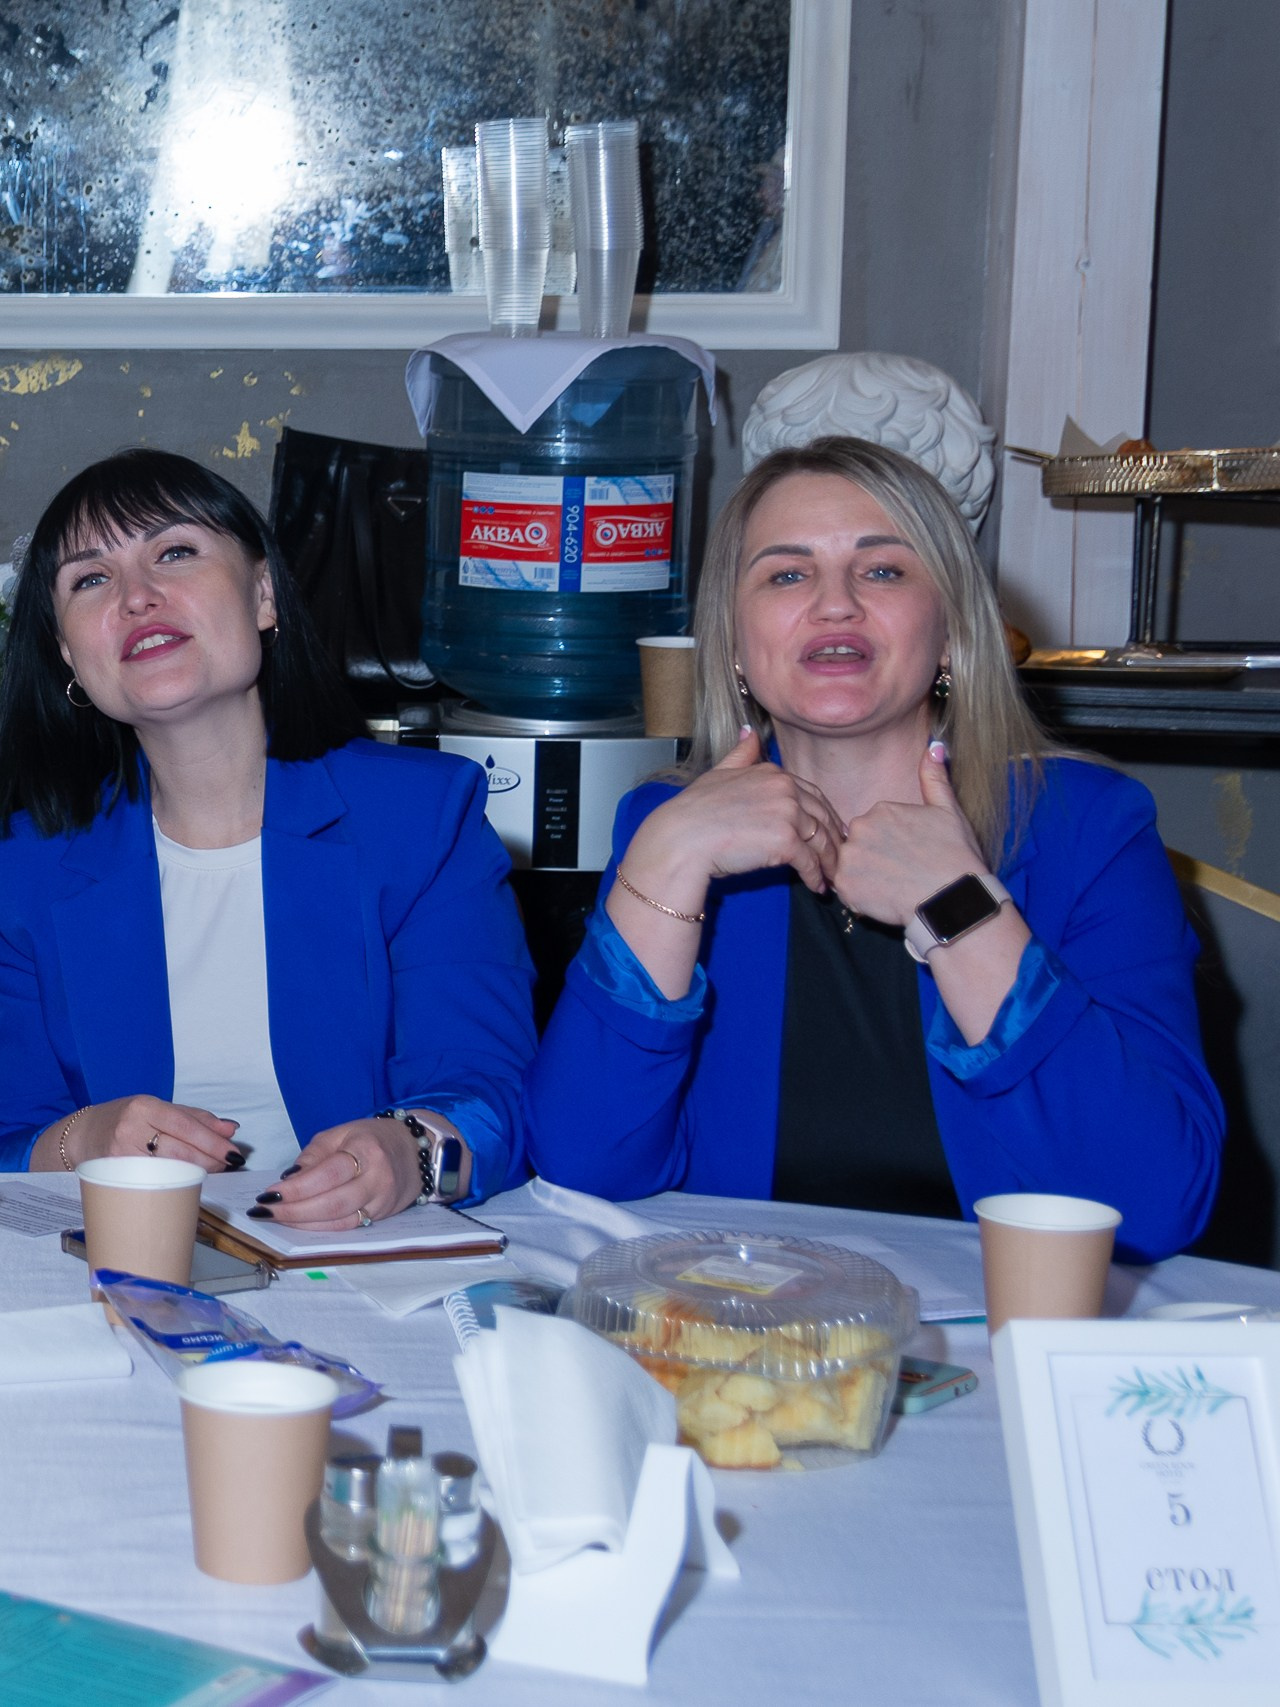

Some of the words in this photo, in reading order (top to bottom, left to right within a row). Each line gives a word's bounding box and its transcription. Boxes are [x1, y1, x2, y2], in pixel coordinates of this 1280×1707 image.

[564, 504, 580, 564] 904-620
[487, 772, 511, 786] ixx
[1167, 1492, 1191, 1526] 5
